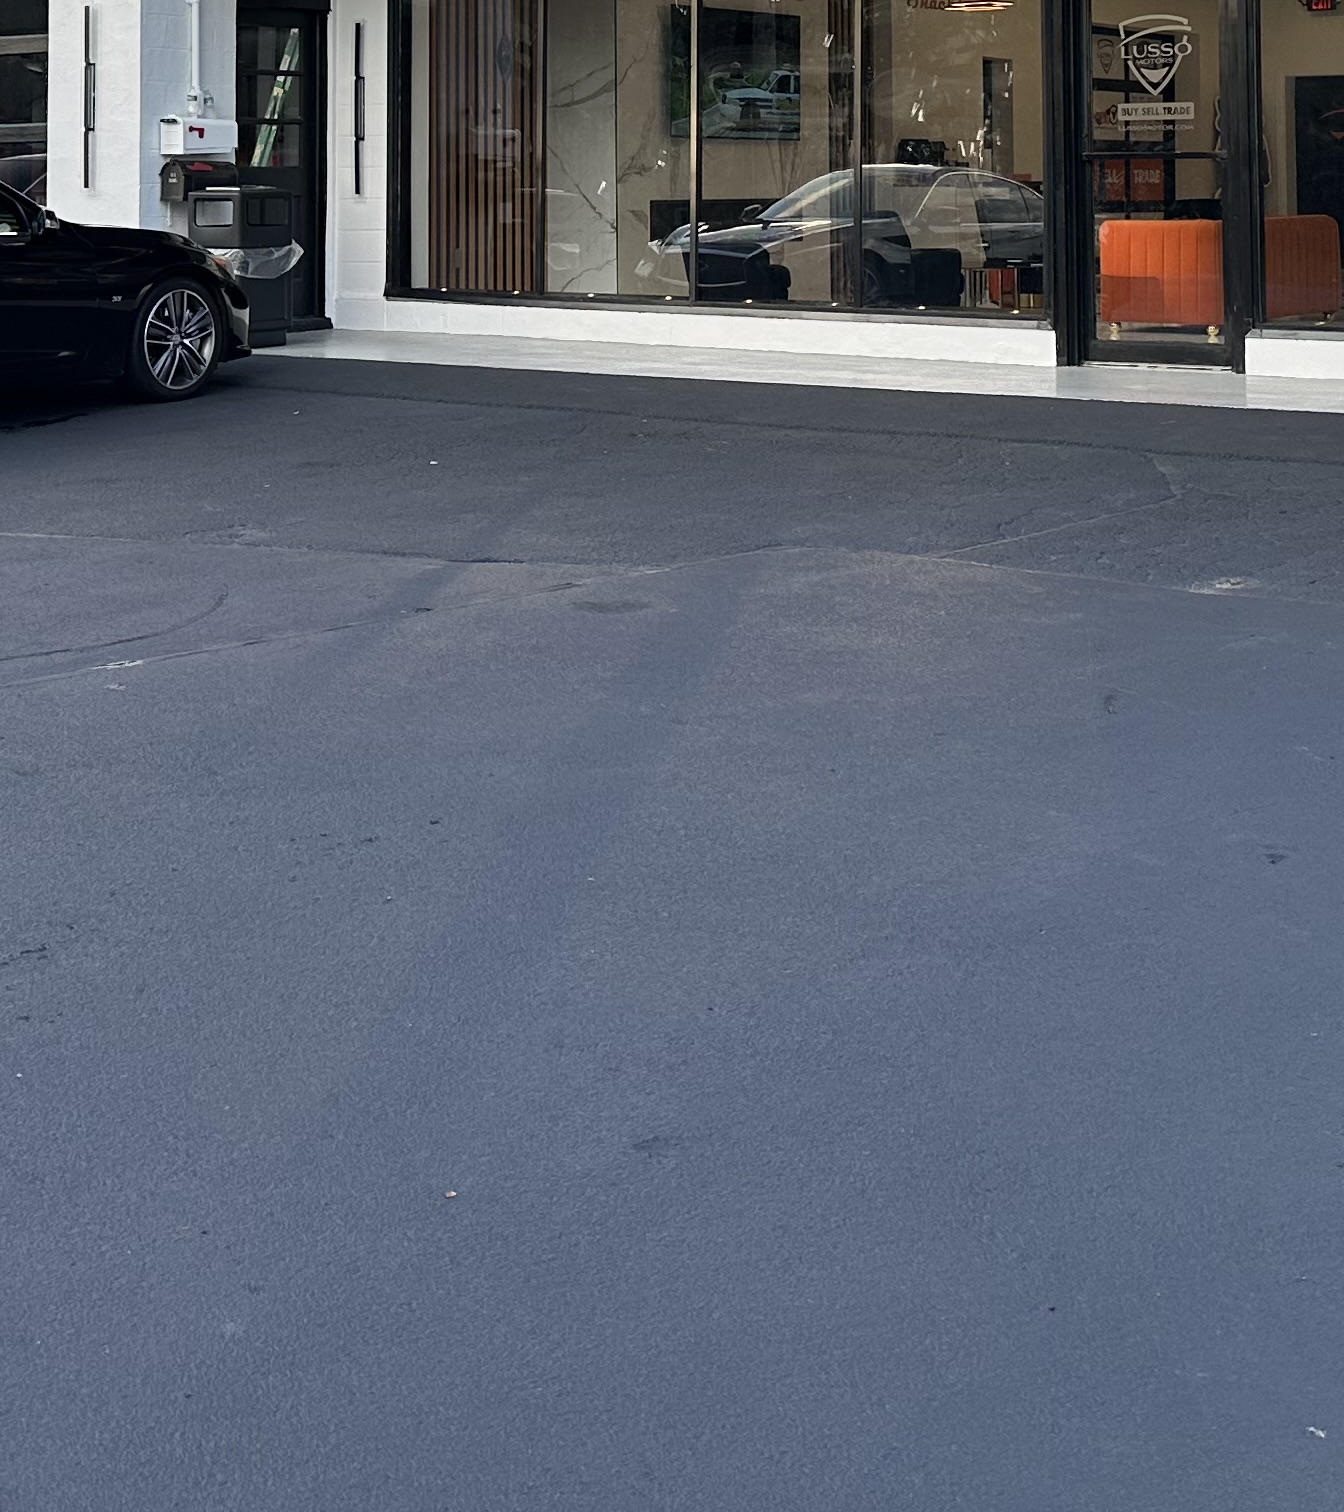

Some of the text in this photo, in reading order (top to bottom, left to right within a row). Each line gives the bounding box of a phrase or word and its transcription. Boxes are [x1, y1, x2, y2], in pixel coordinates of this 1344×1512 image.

[1121, 42, 1193, 59] LUSSO
[1135, 57, 1174, 65] MOTORS
[1132, 168, 1161, 184] TRADE
